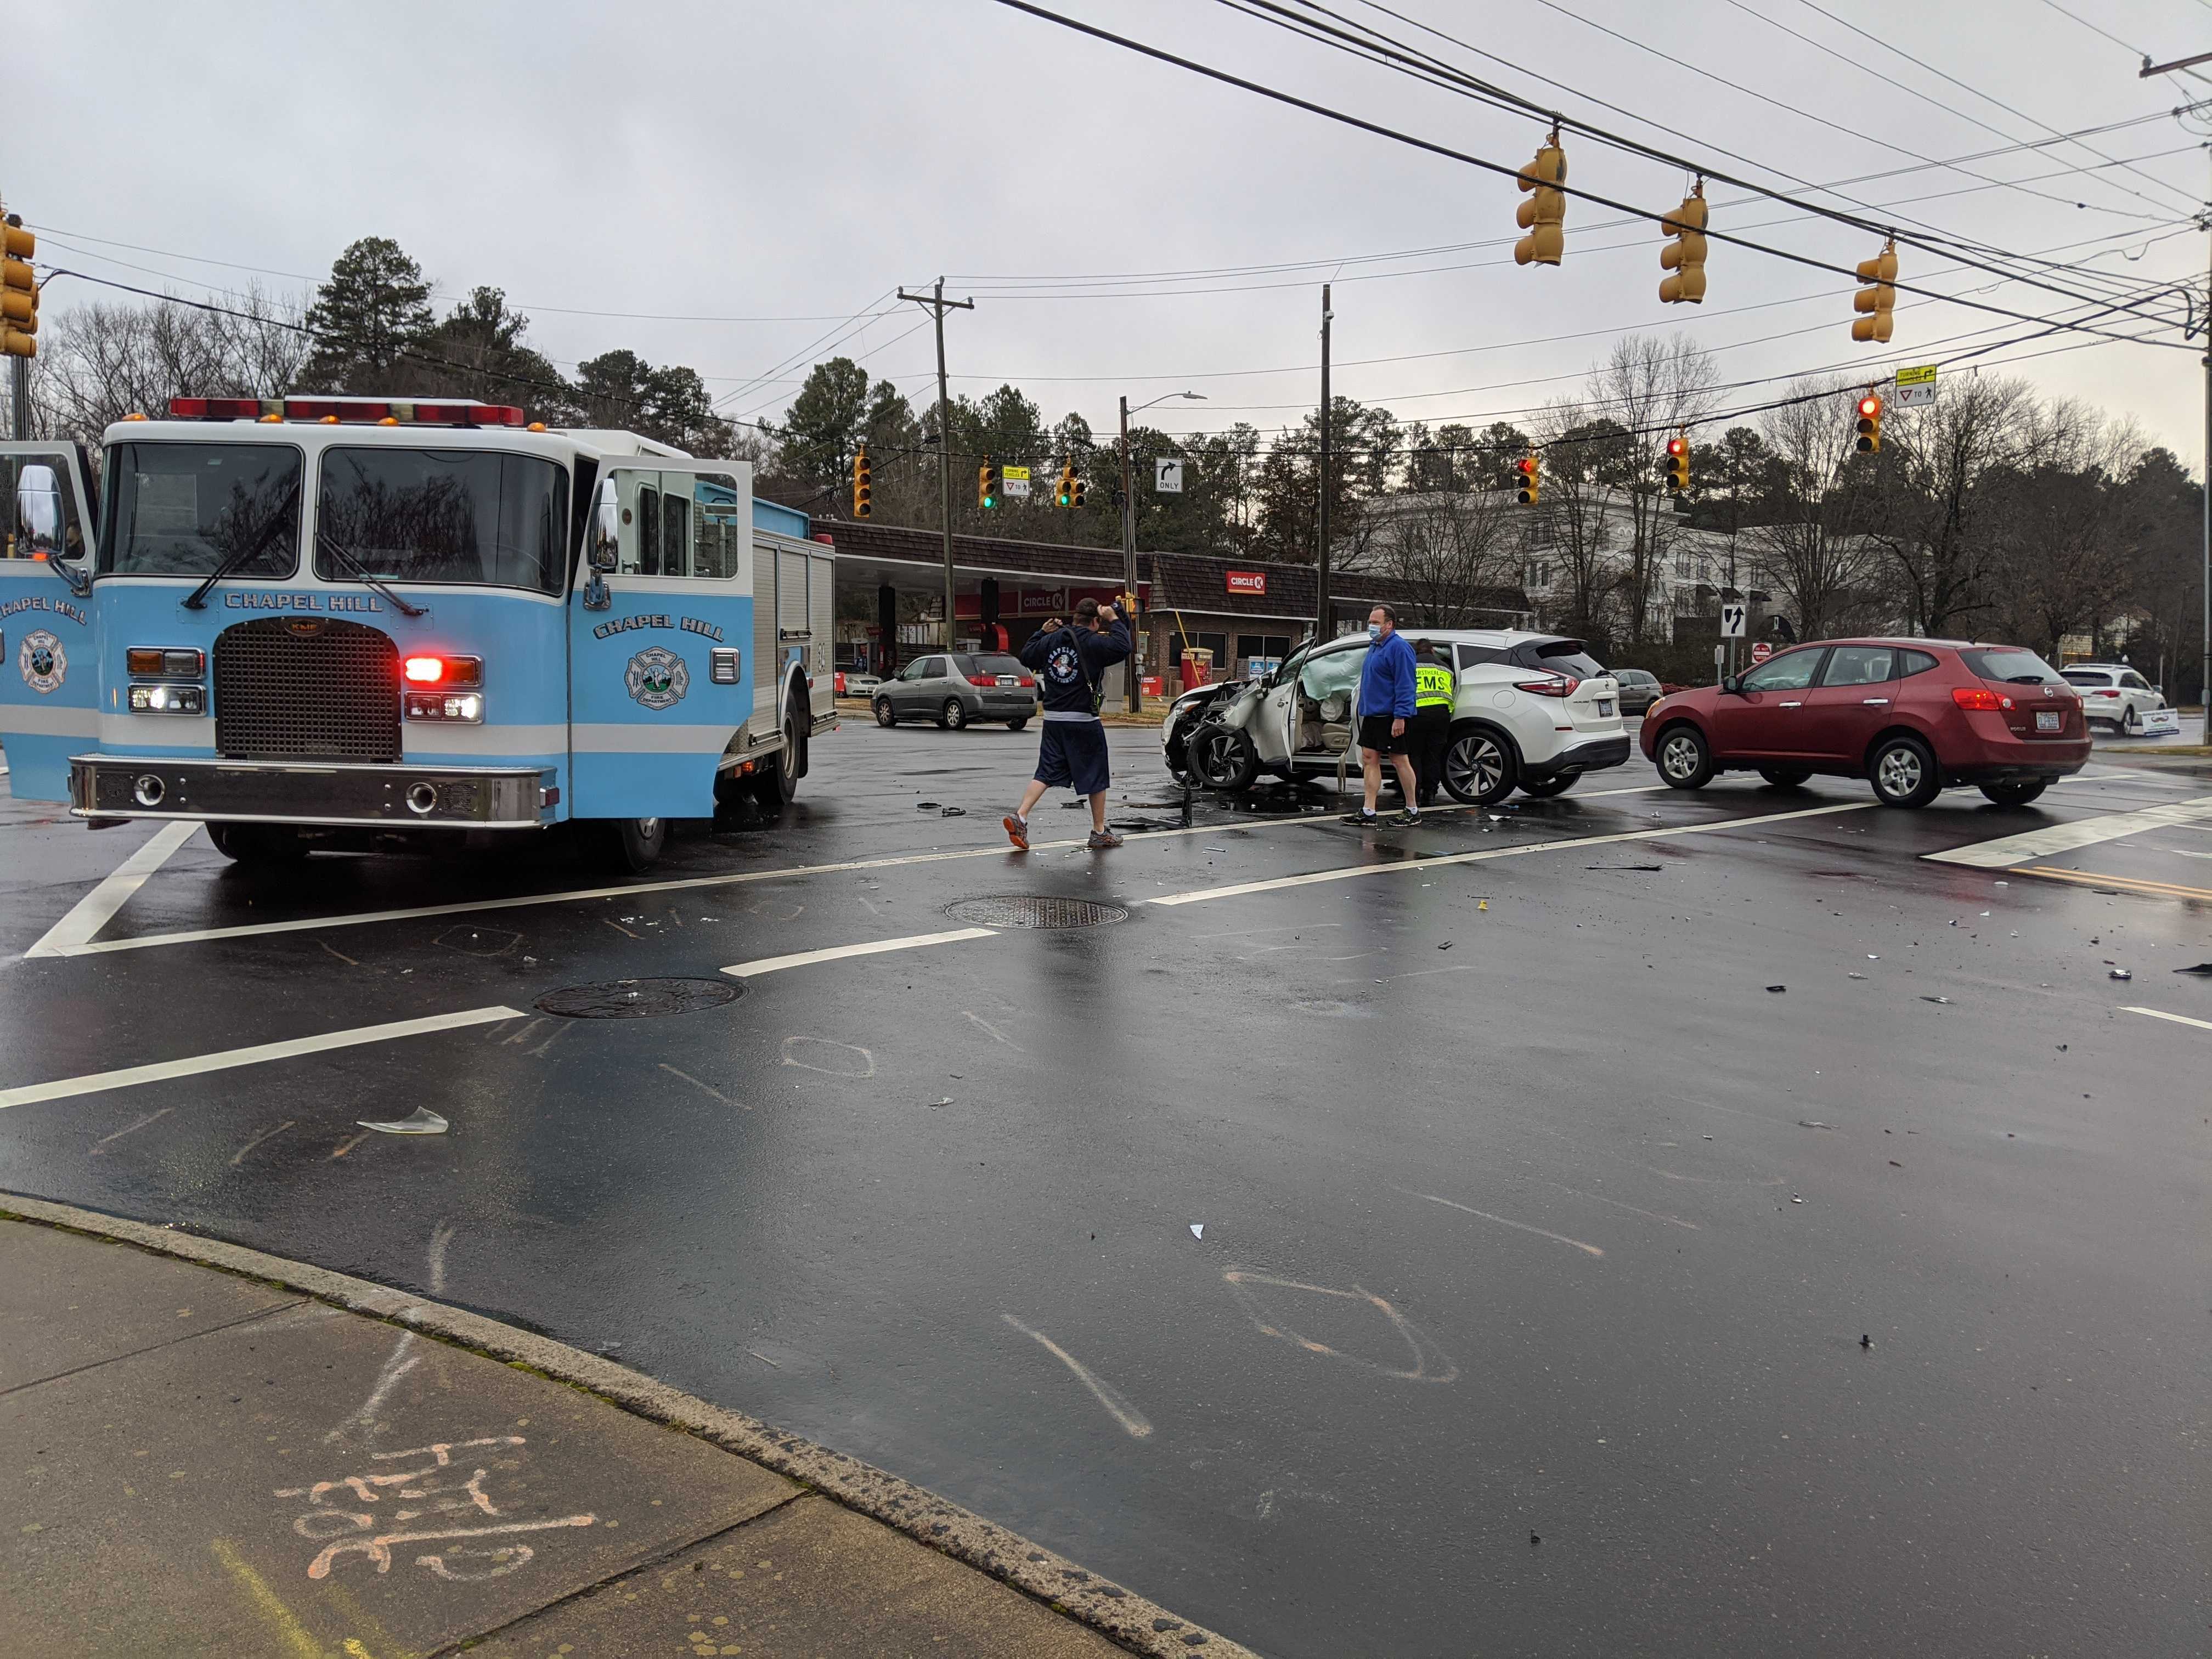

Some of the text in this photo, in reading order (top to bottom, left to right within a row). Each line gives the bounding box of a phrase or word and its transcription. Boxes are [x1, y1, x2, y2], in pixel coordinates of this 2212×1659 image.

[1231, 577, 1254, 586] CIRCLE
[0, 597, 87, 626] HAPEL HILL
[225, 593, 383, 612] CHAPEL HILL
[1024, 596, 1051, 607] CIRCLE
[593, 614, 724, 642] CHAPEL HILL
[817, 642, 825, 672] 34
